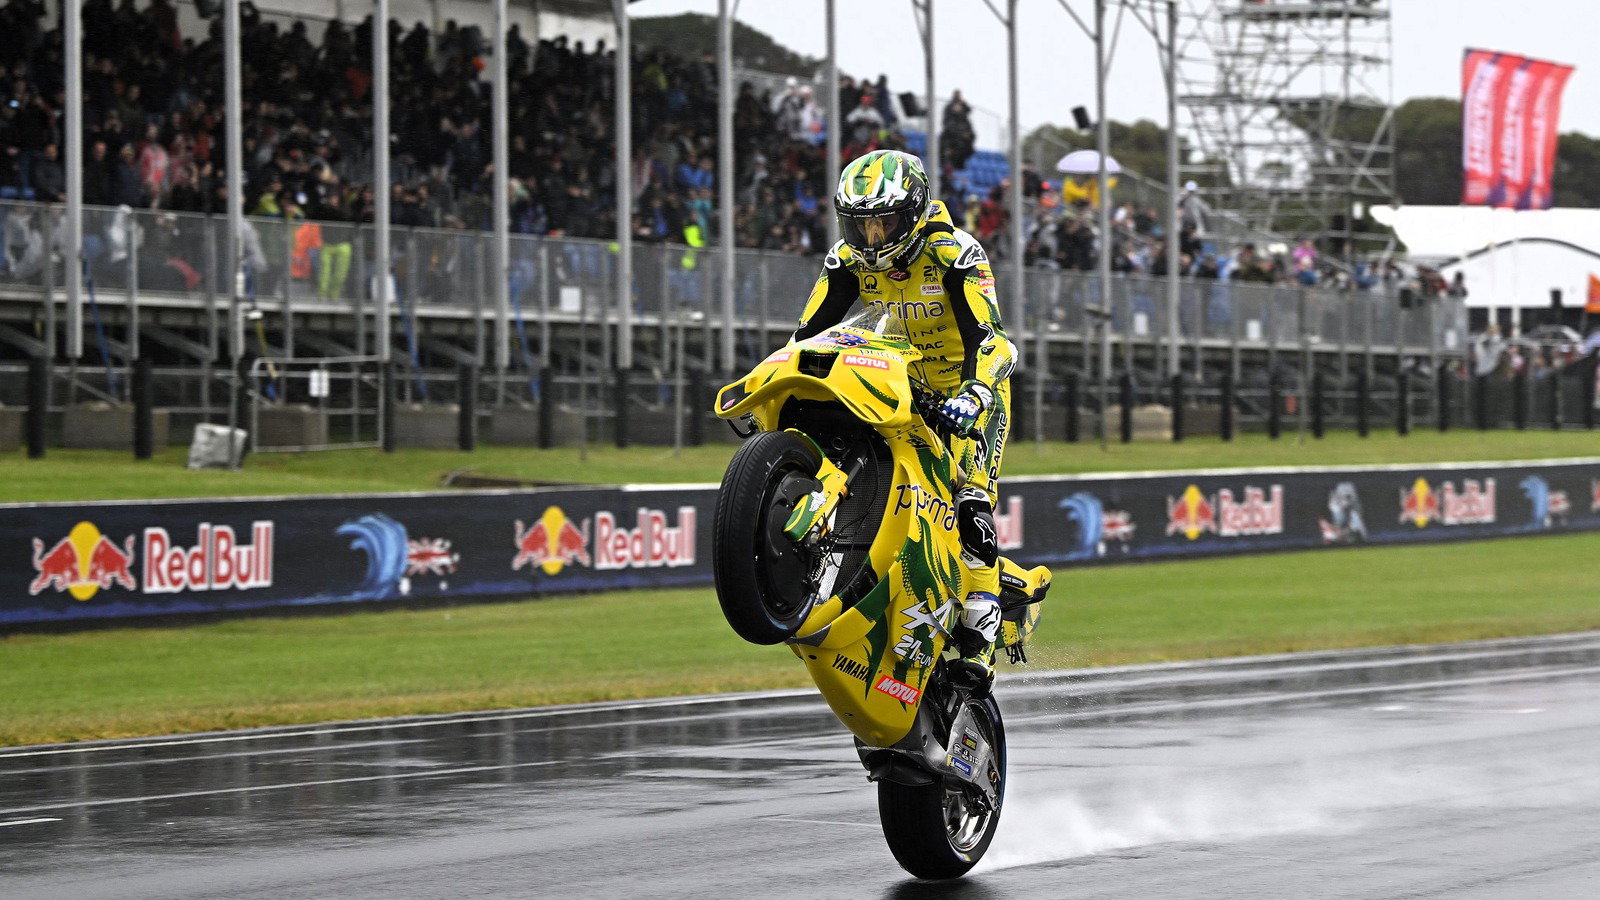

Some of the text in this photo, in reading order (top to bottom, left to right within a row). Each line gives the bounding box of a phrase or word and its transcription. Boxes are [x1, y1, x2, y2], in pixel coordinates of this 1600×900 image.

[844, 355, 888, 369] MOTUL
[986, 413, 1008, 494] PRAMAC
[831, 653, 871, 683] YAMAHA
[877, 677, 919, 704] MOTUL
